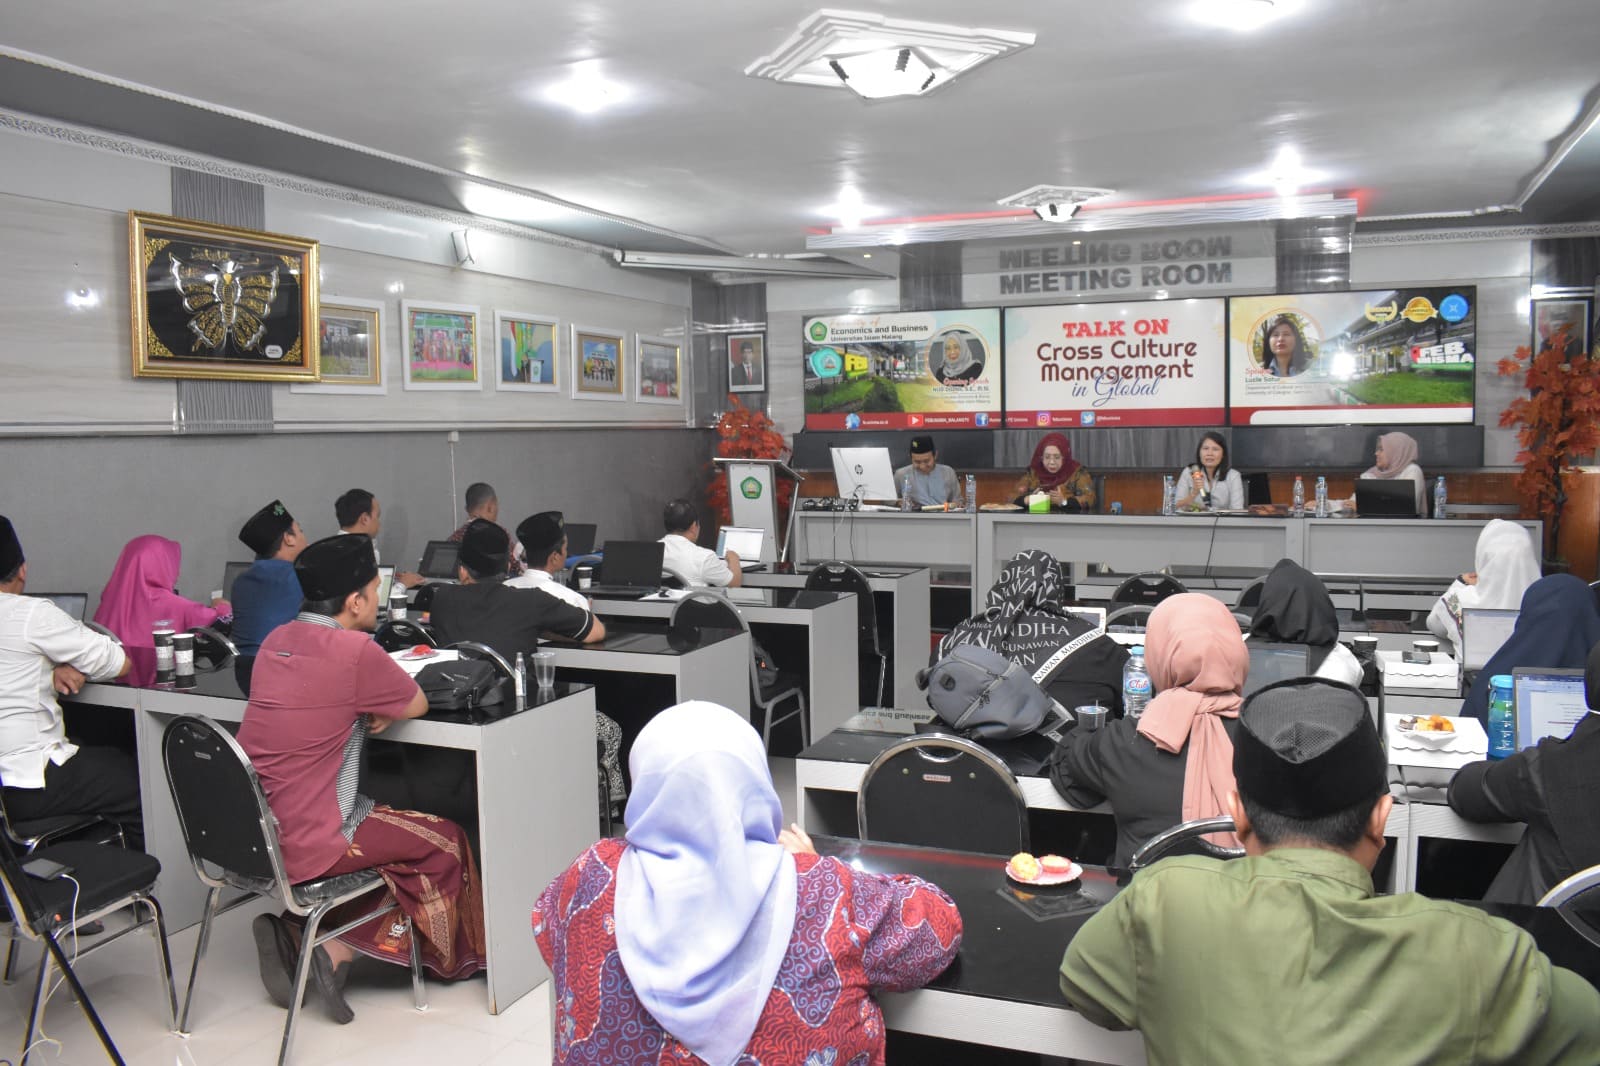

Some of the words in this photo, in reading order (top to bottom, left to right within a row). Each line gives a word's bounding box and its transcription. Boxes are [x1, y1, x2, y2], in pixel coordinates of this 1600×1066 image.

[1000, 268, 1131, 295] MEETING
[1141, 262, 1232, 287] ROOM
[831, 327, 873, 335] Economics
[892, 325, 929, 333] Business
[1063, 320, 1125, 338] TALK
[1133, 318, 1169, 336] ON
[1037, 343, 1103, 361] Cross
[1110, 338, 1198, 359] Culture
[1041, 358, 1194, 385] Management
[1072, 382, 1088, 397] in
[1092, 370, 1162, 407] Global
[1001, 639, 1060, 653] GUNAWAN
